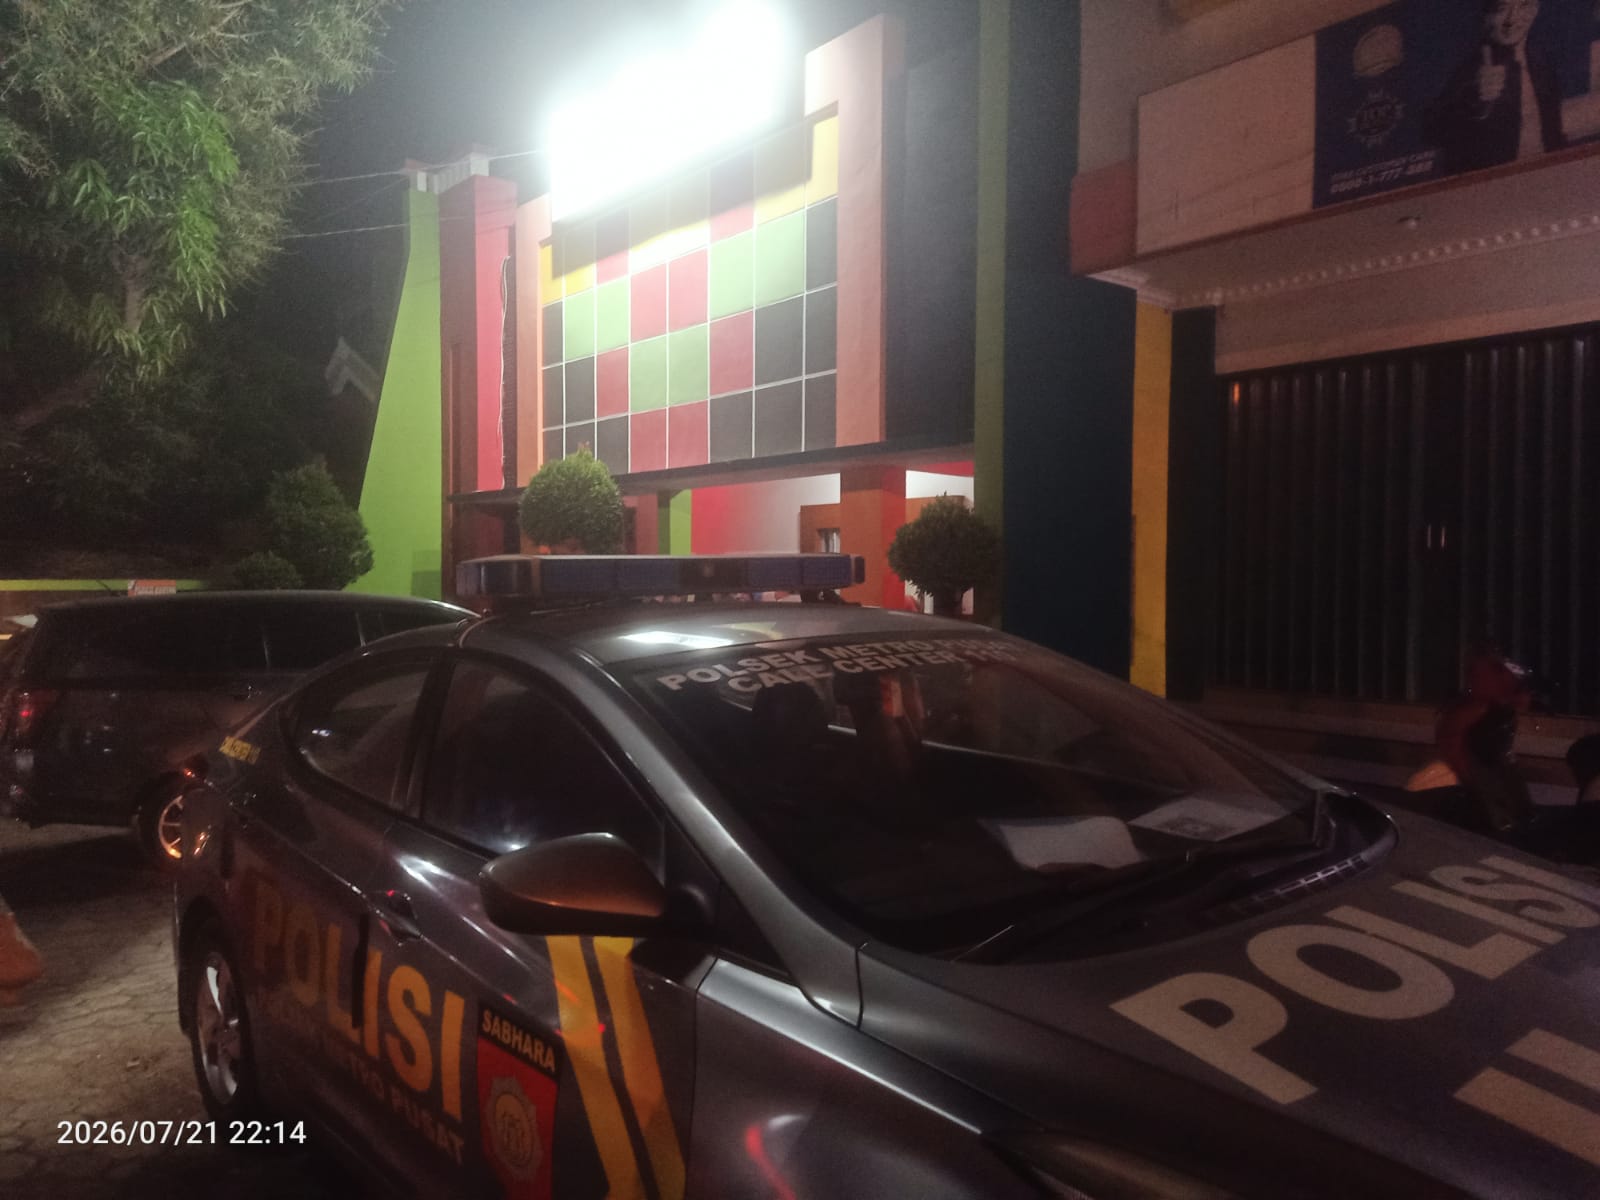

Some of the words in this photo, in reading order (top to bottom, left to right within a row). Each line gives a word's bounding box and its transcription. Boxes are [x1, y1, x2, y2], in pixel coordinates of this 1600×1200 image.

[656, 650, 823, 691] POLSEK
[818, 639, 935, 660] METRO
[727, 663, 834, 692] CALL
[831, 650, 967, 673] CENTER
[254, 876, 465, 1122] POLISI
[1108, 855, 1600, 1105] POLISI
[482, 1009, 556, 1073] SABHARA
